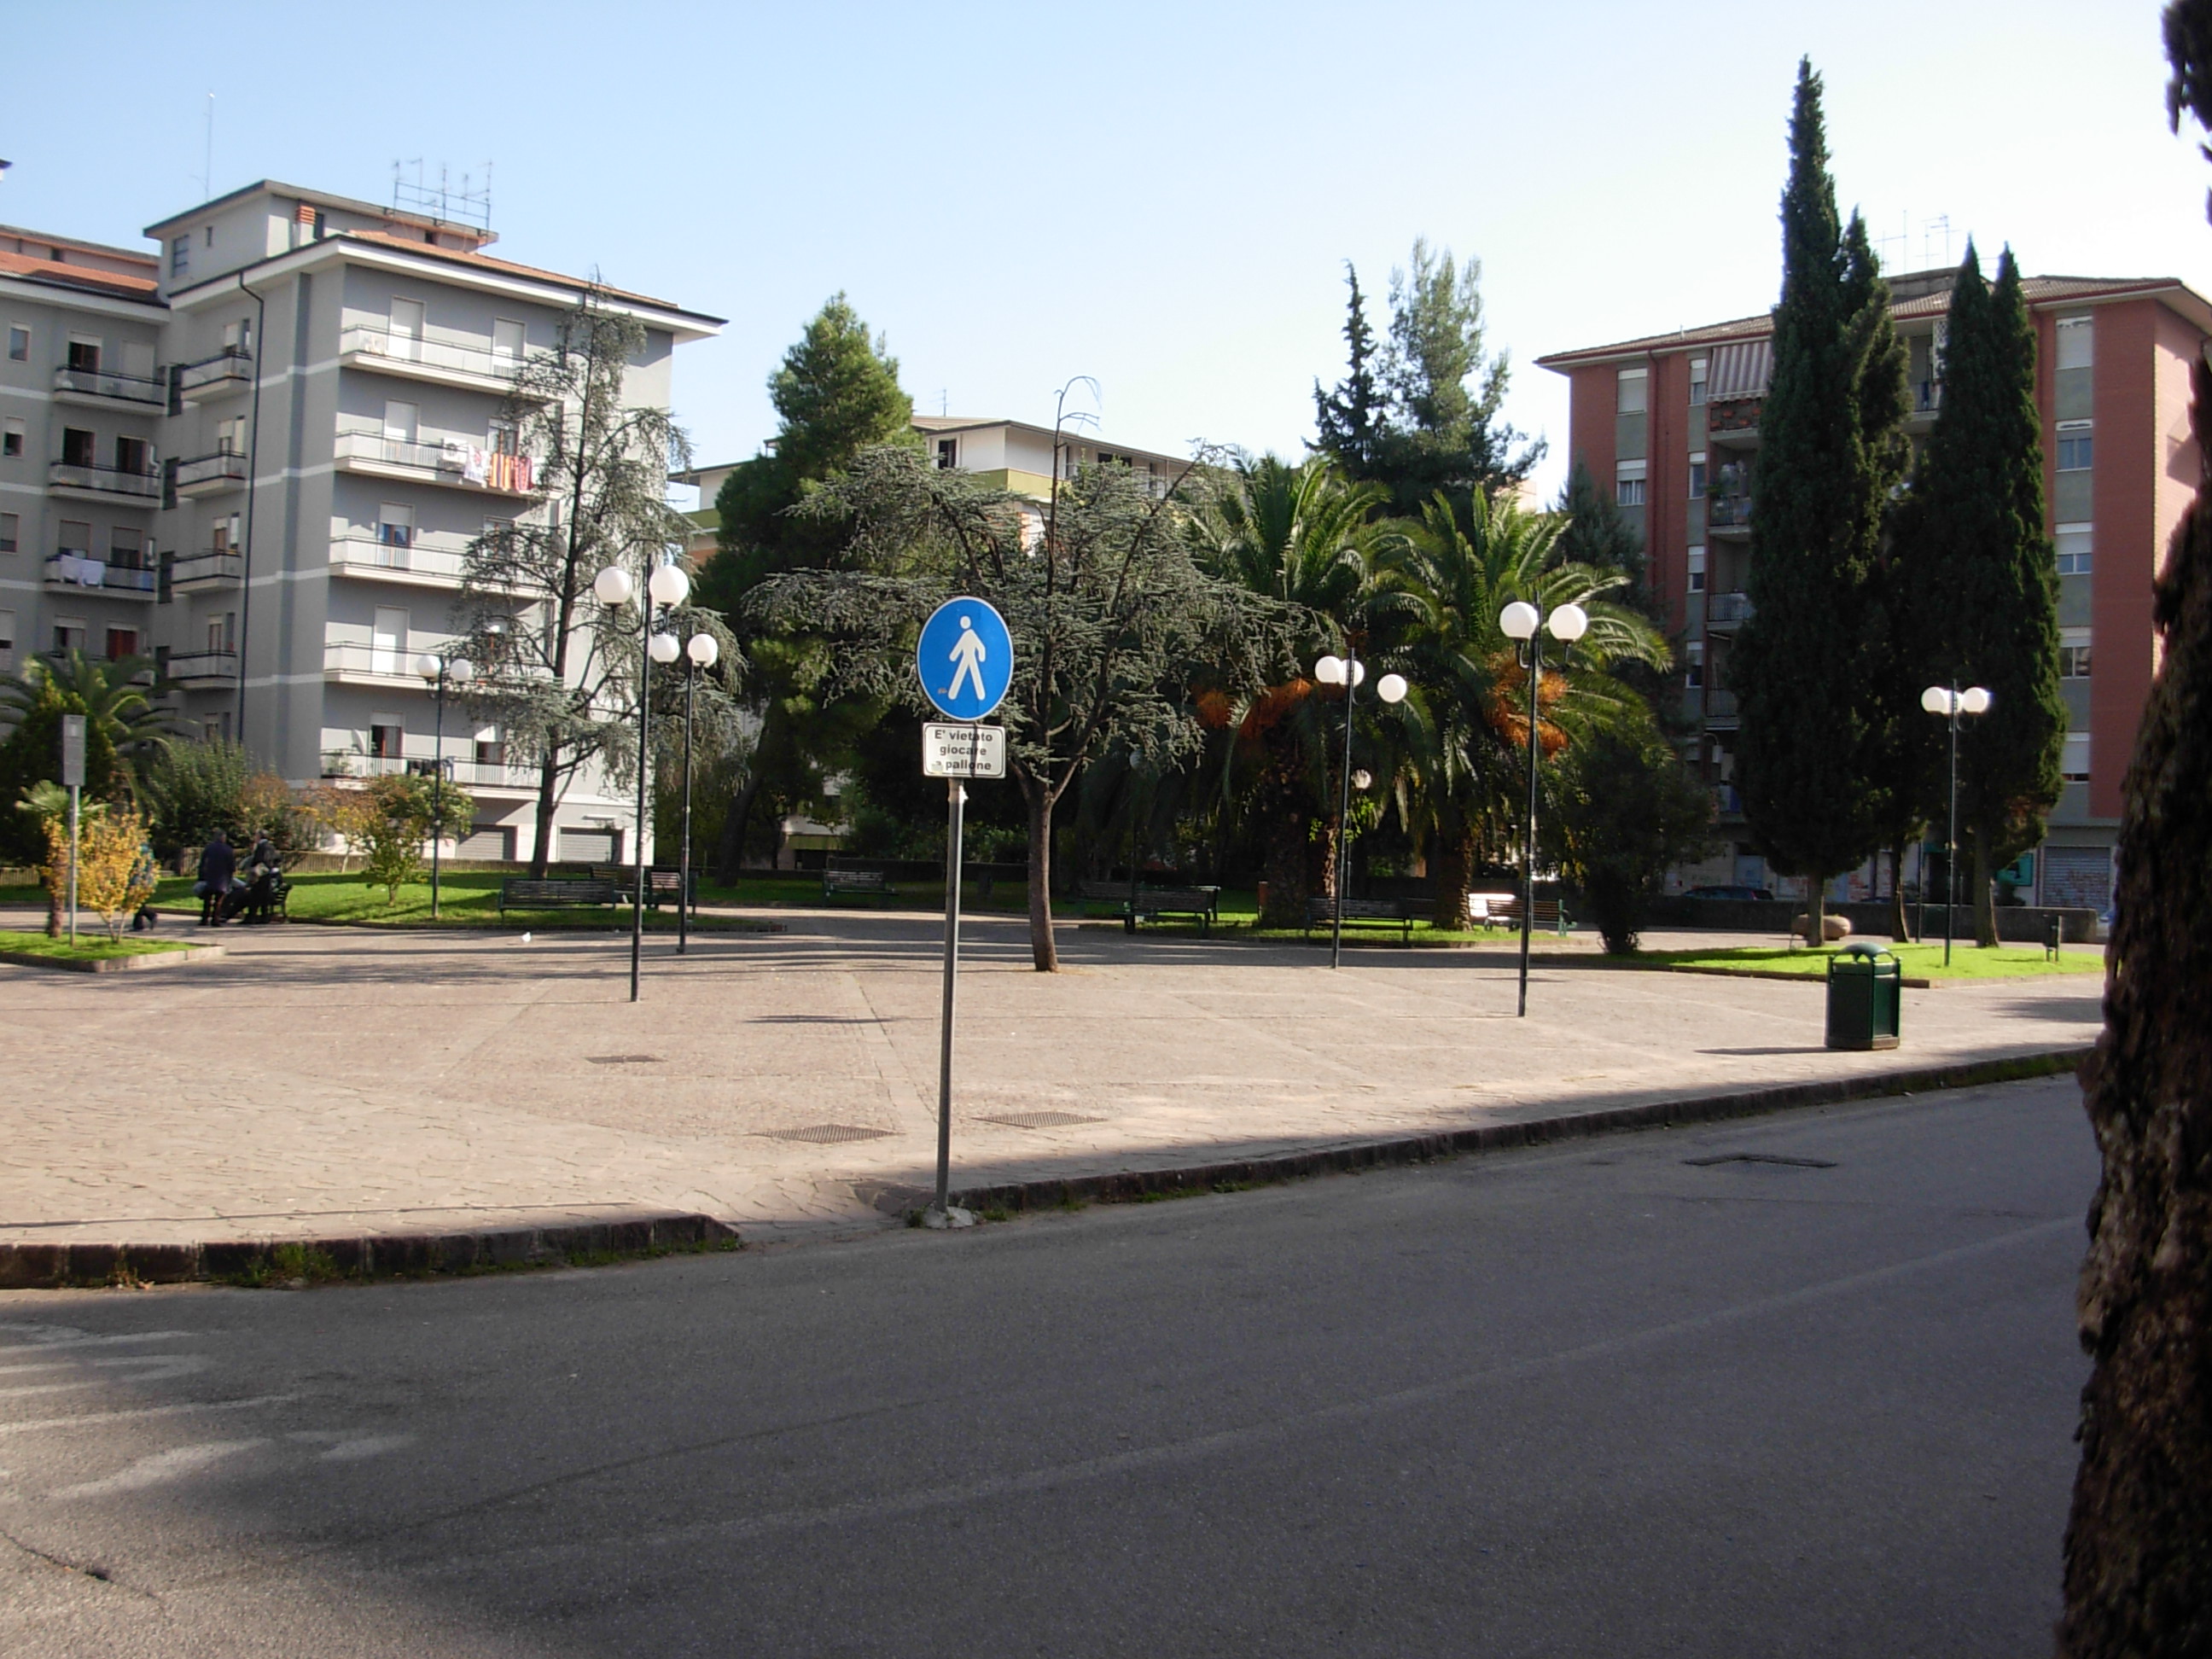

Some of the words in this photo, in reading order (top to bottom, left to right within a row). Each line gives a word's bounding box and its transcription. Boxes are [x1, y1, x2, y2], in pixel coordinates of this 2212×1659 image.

[934, 730, 946, 739] E'
[949, 731, 992, 742] vietato
[940, 744, 987, 755] giocare
[946, 760, 992, 771] pallone
